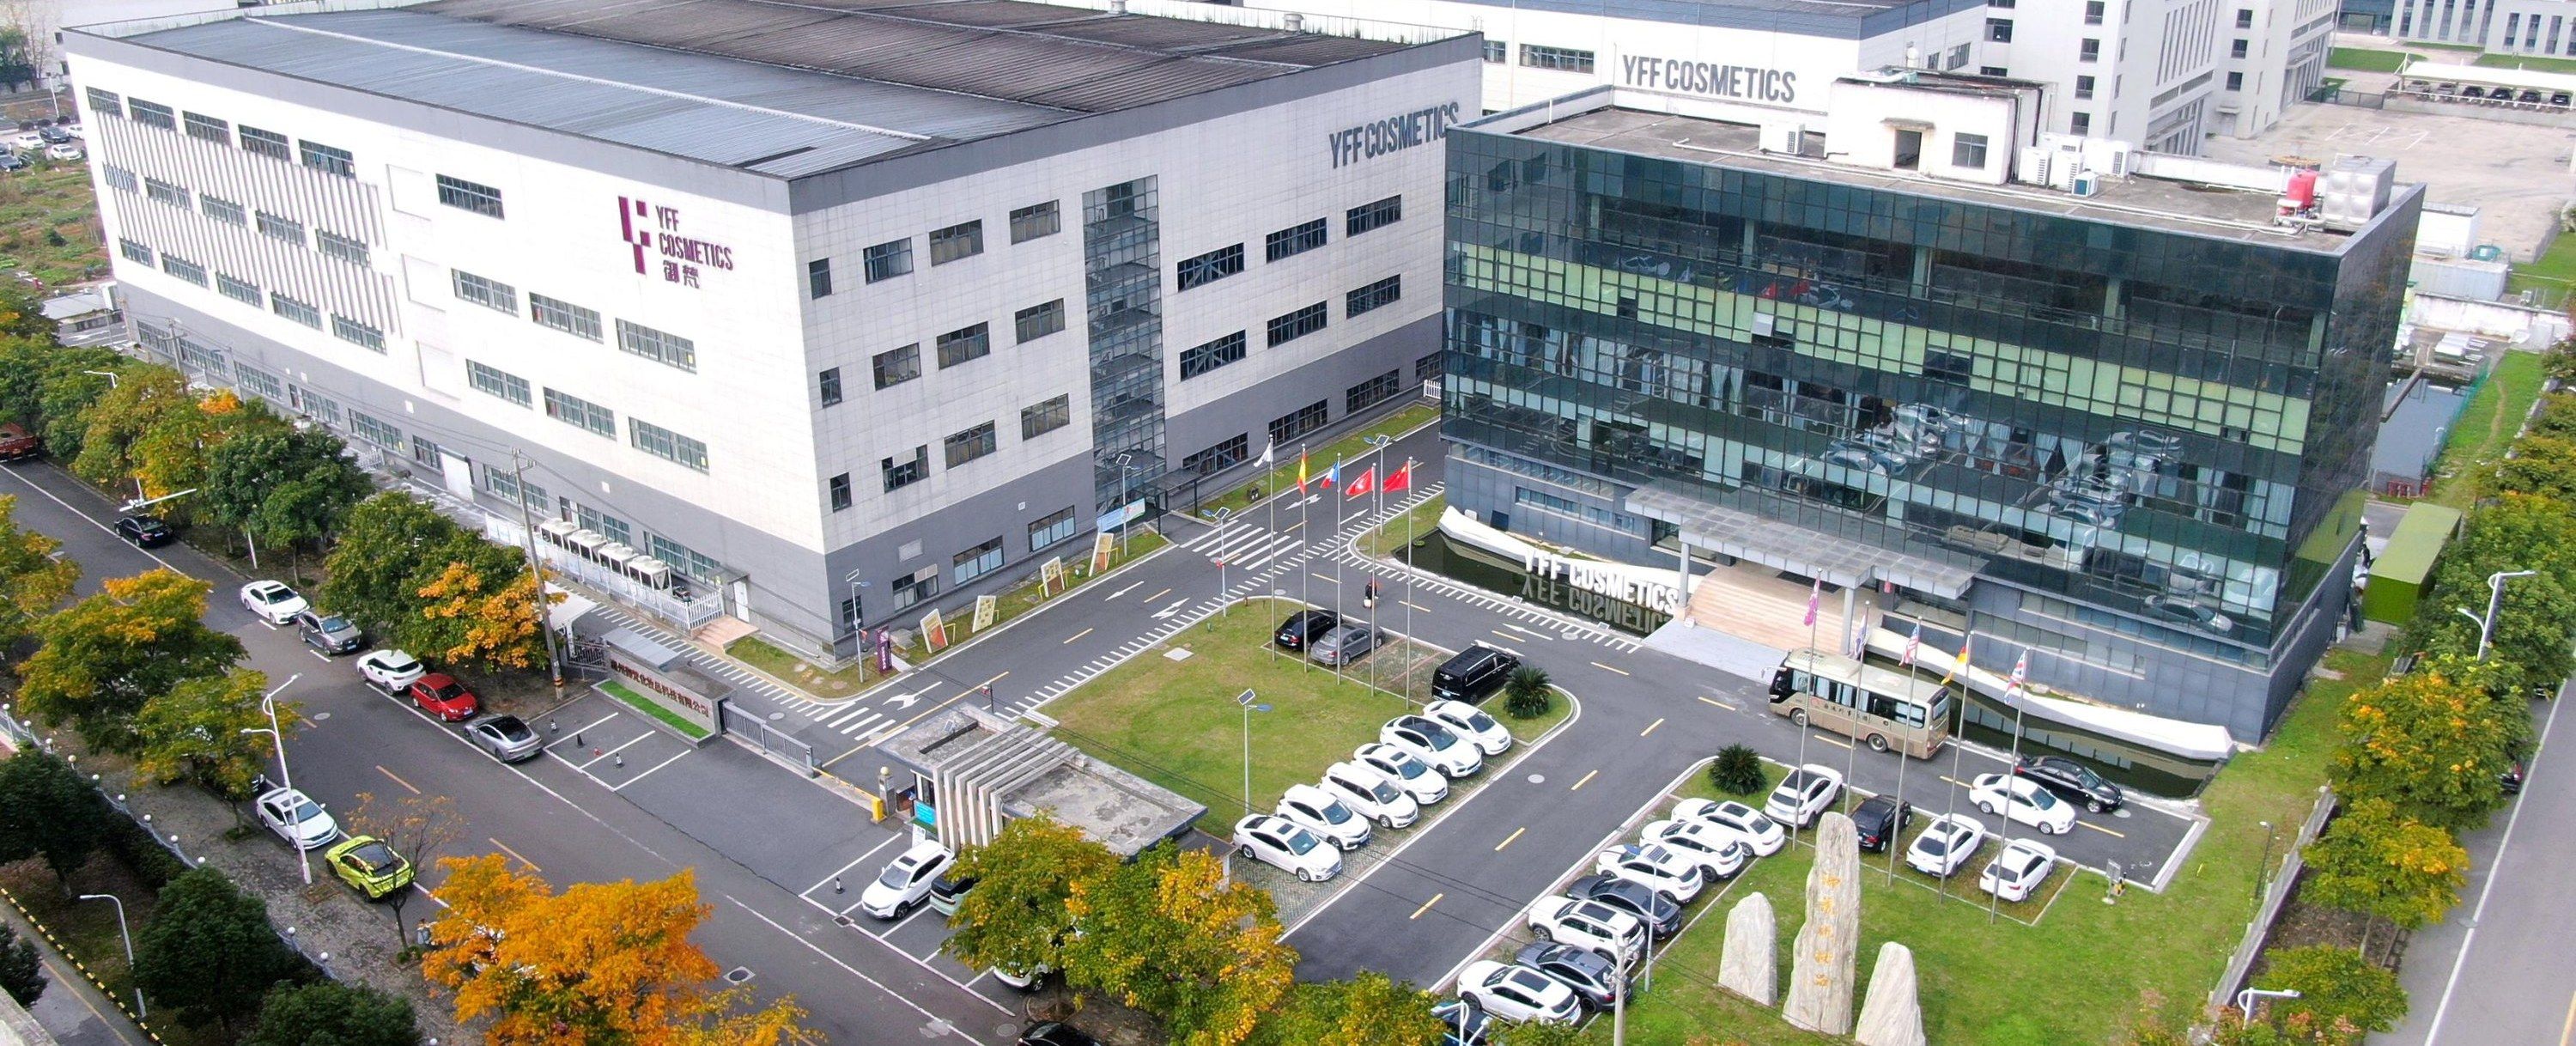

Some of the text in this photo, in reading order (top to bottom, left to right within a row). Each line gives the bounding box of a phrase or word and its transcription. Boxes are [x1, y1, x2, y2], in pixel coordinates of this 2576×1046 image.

[1622, 54, 1796, 103] YFF COSMETICS
[1329, 101, 1459, 169] YFF COSMETICS
[655, 204, 680, 232] YFF
[659, 232, 734, 271] COSMETICS
[1523, 549, 1680, 616] YFF COSMETICS
